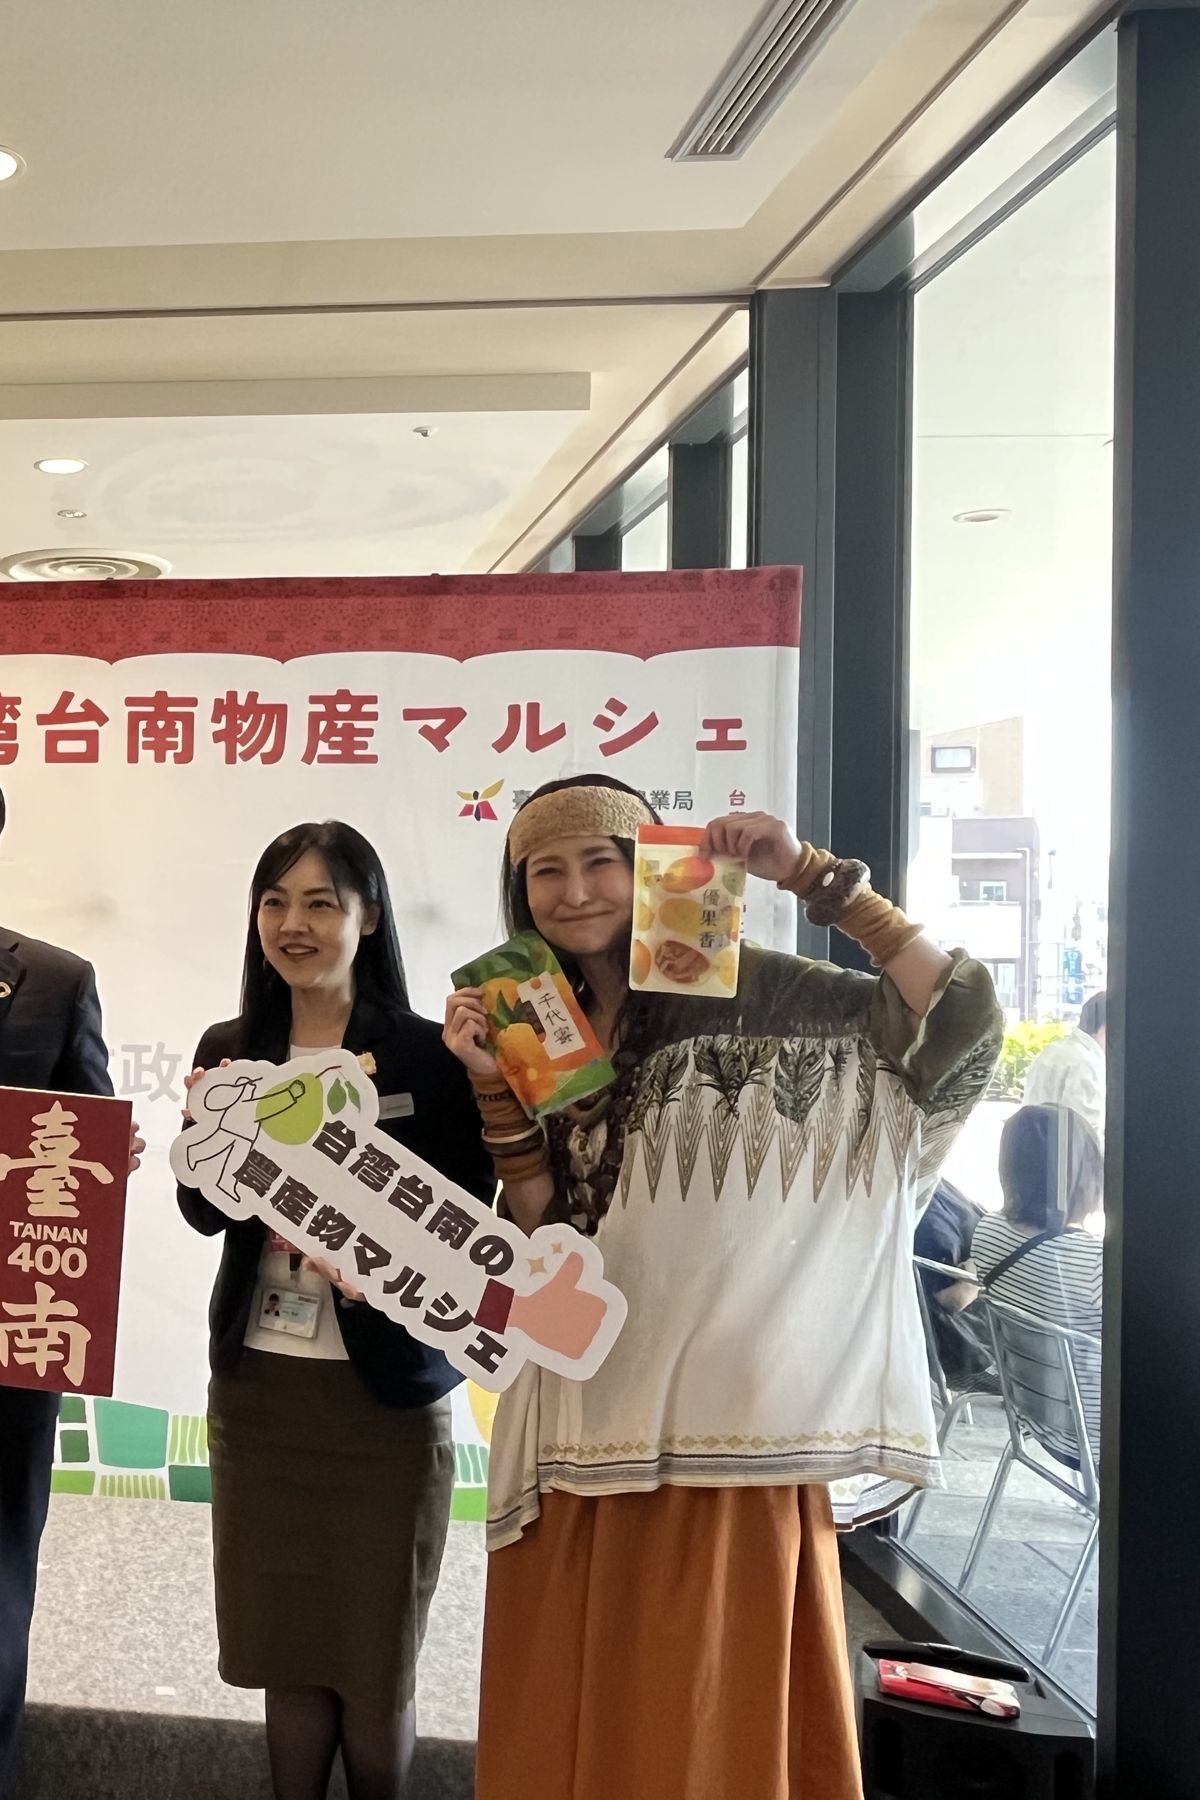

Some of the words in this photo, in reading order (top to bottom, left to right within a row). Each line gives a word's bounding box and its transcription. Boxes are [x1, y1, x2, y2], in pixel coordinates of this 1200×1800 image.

[9, 1221, 88, 1245] TAINAN
[312, 1120, 514, 1276] 台湾台南の
[7, 1242, 88, 1279] 400
[232, 1149, 508, 1374] 農産物マルシェ
